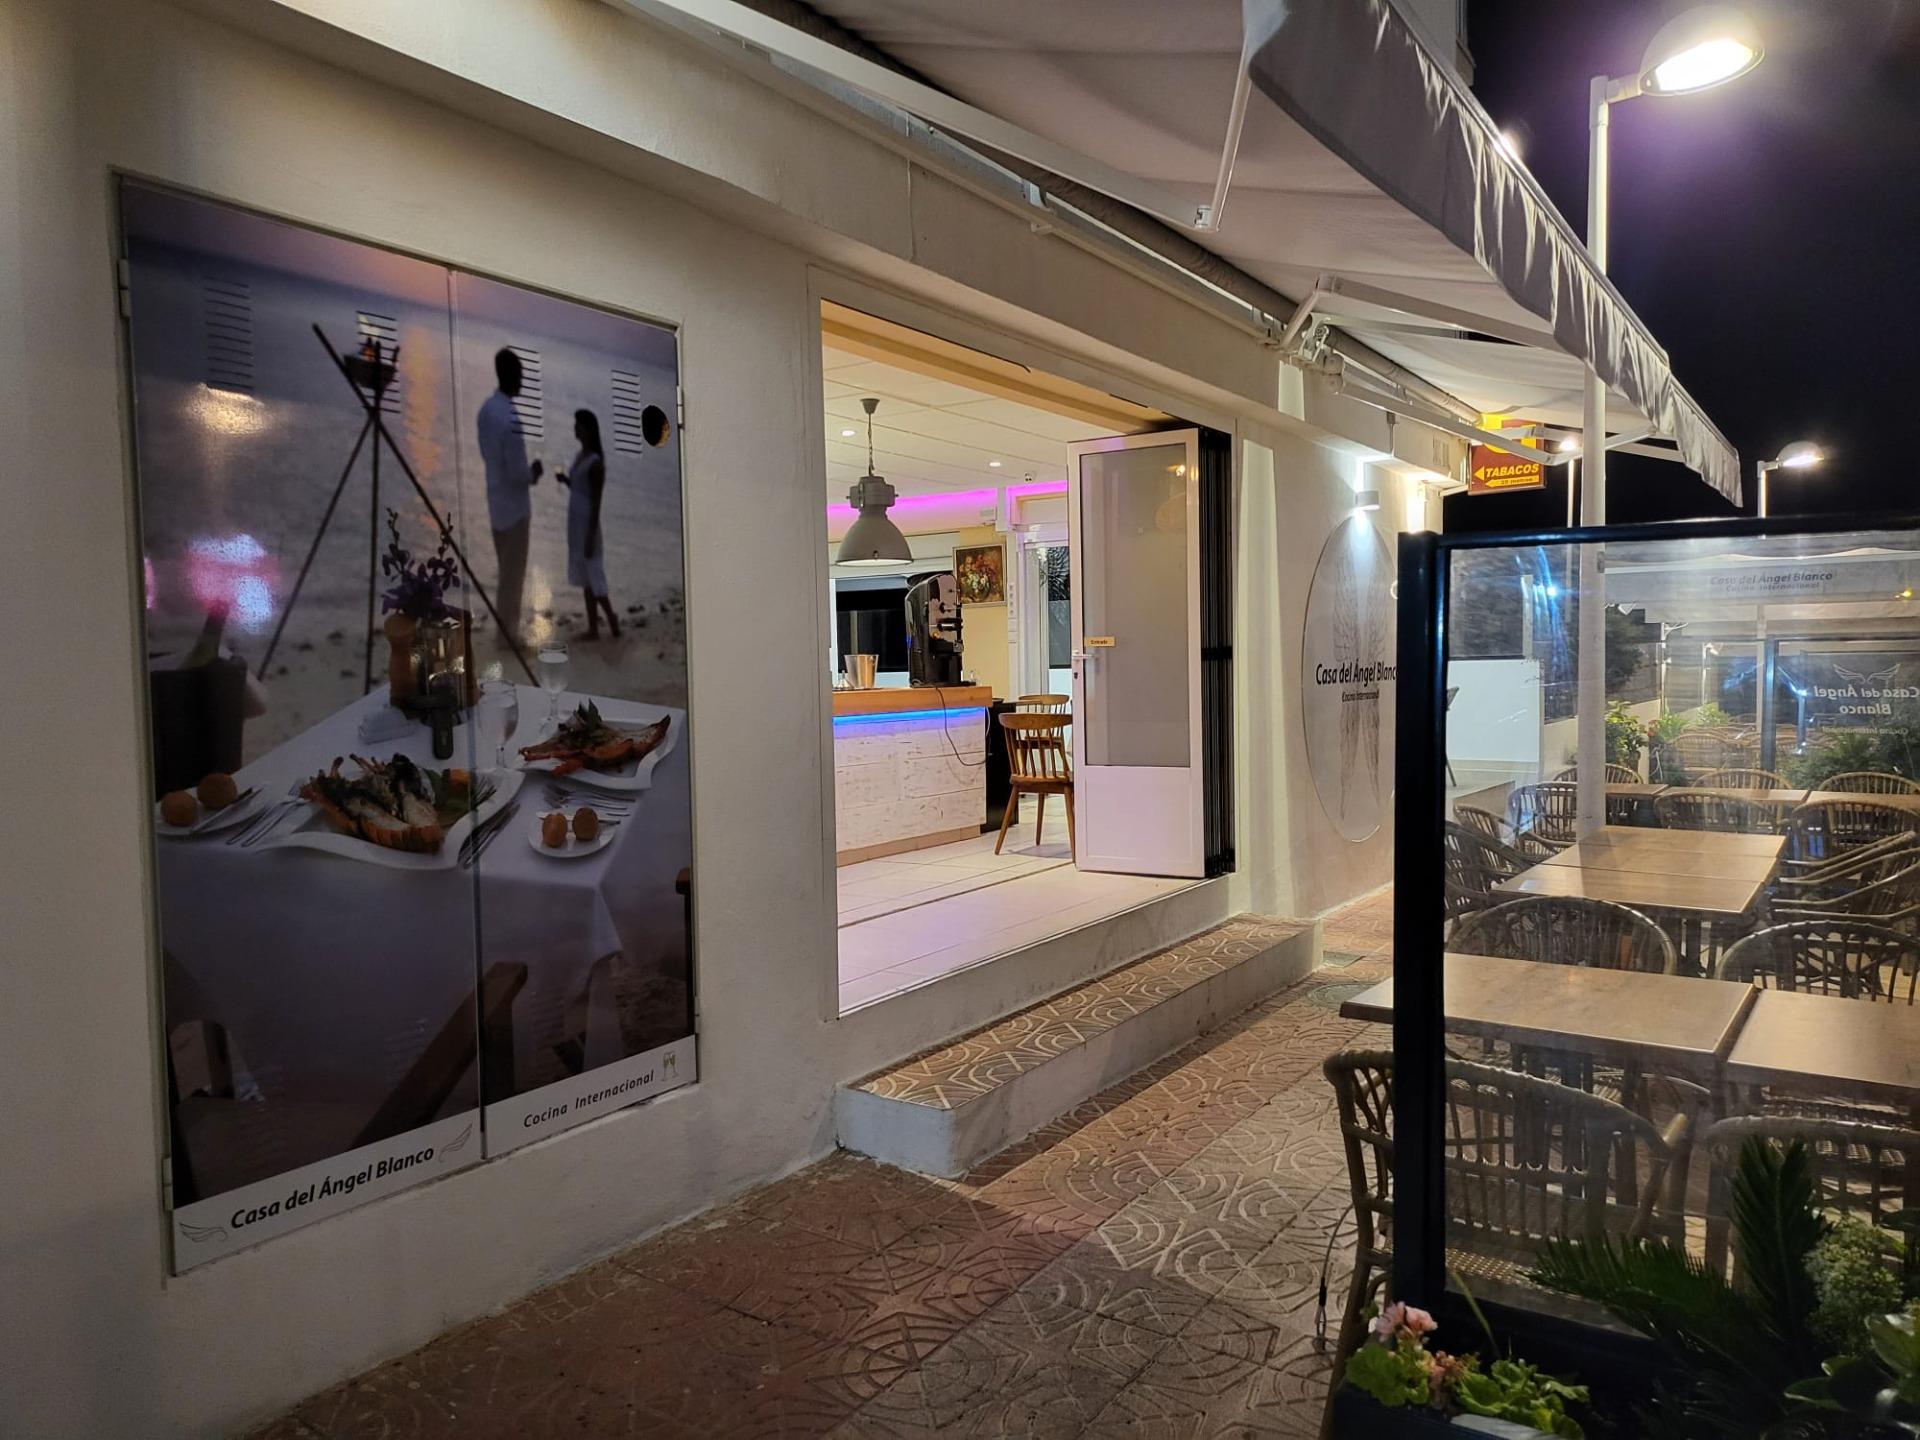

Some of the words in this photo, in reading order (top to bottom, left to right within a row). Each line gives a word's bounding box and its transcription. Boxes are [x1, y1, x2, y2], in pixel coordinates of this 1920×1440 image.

[1485, 463, 1540, 478] TABACOS
[1740, 575, 1756, 585] del
[1758, 571, 1791, 584] Ángel
[1793, 571, 1833, 582] Blanco
[1315, 663, 1338, 685] Casa
[1339, 662, 1352, 684] del
[1353, 658, 1376, 688] Ángel
[1376, 661, 1397, 681] Blanc
[523, 1104, 568, 1128] Cocina
[575, 1069, 654, 1110] Internacional
[230, 1200, 280, 1229] Casa
[284, 1184, 316, 1211] del
[318, 1164, 373, 1199] Ángel
[375, 1147, 435, 1178] Blanco
